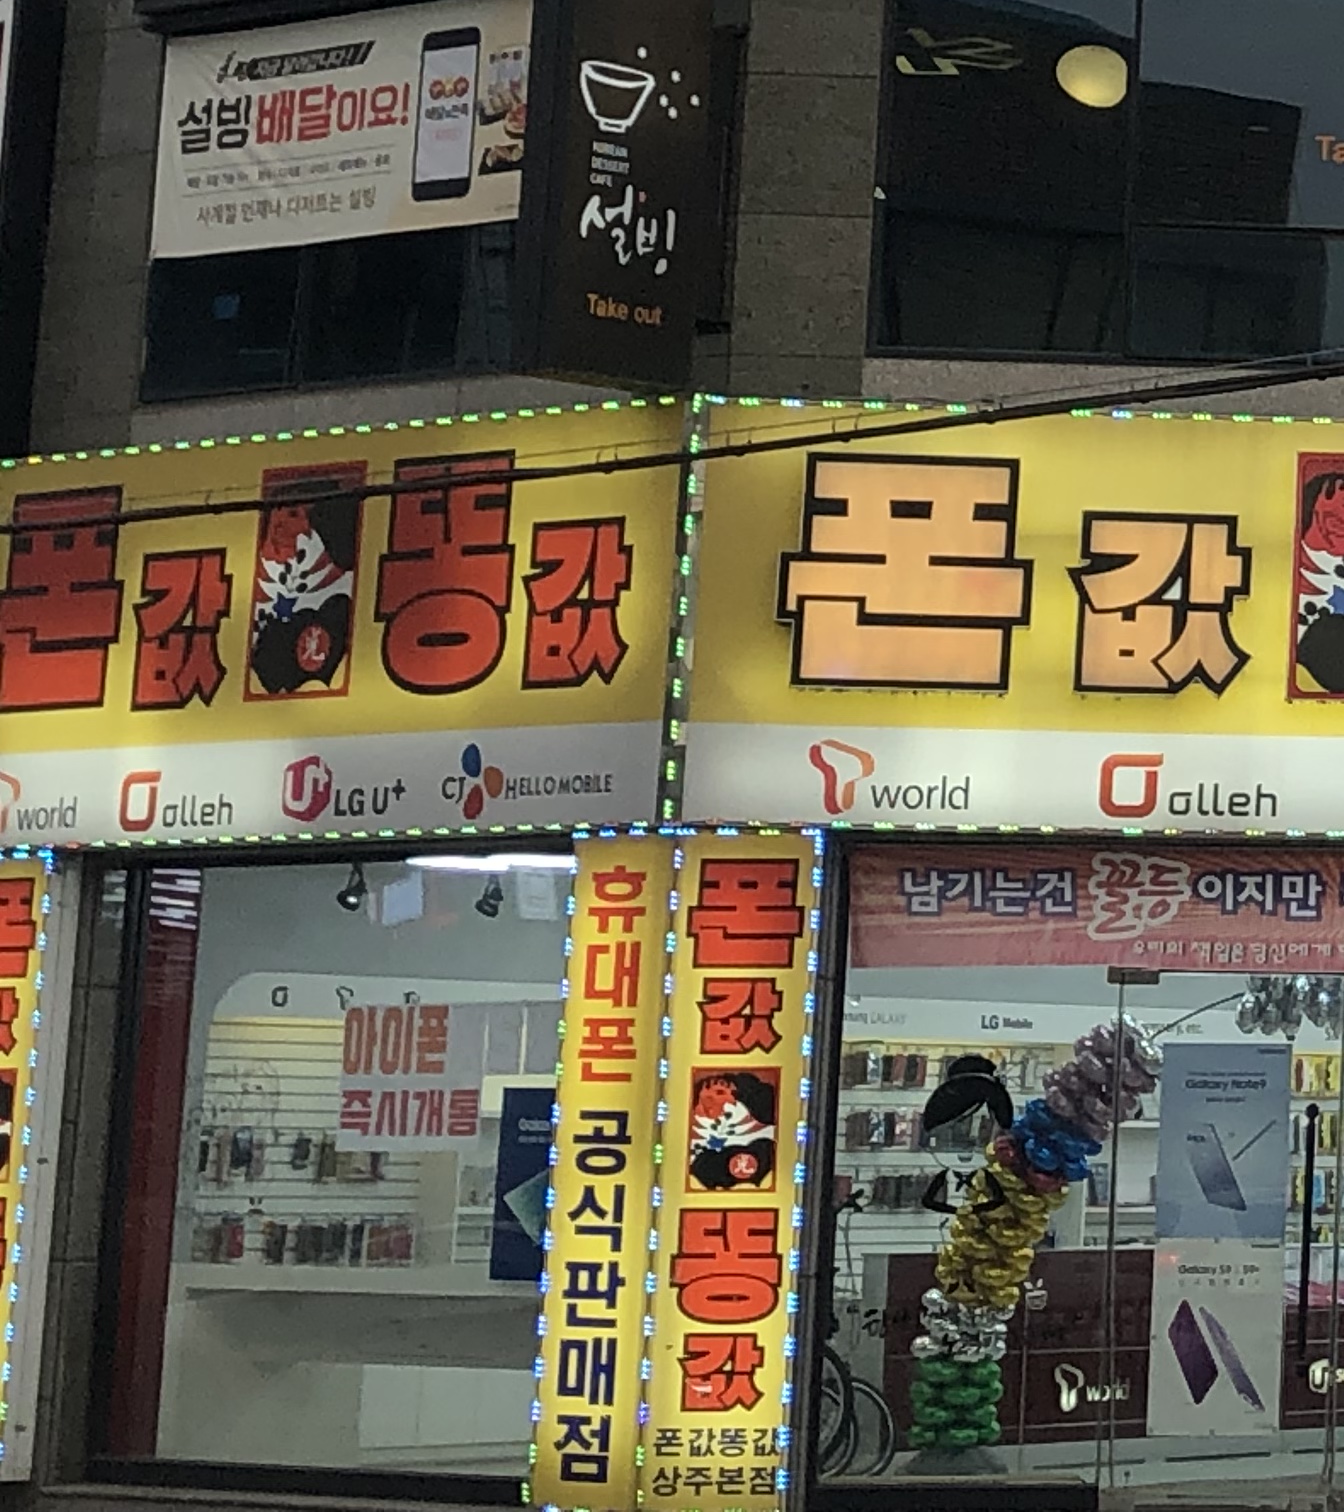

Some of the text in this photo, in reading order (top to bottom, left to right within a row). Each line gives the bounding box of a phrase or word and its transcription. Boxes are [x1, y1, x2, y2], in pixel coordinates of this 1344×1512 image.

[177, 82, 411, 155] 설빙 배달이요!
[579, 184, 676, 275] 설빙
[586, 293, 662, 326] Take out
[334, 789, 364, 817] LG
[441, 775, 467, 804] CJ
[870, 775, 970, 810] world
[1168, 784, 1277, 817] olleh
[16, 794, 77, 830] world
[162, 798, 233, 827] olleh
[902, 867, 1078, 918] 남기는건
[577, 864, 647, 1082] 휴대폰
[981, 1014, 999, 1029] LG
[342, 1005, 450, 1075] 아이폰
[340, 1088, 480, 1137] 즉시개통
[669, 858, 804, 1413] 폰값 똥값
[553, 1108, 633, 1484] 공식판매점
[653, 1426, 780, 1460] 폰값똥값
[651, 1466, 779, 1498] 상주본점
